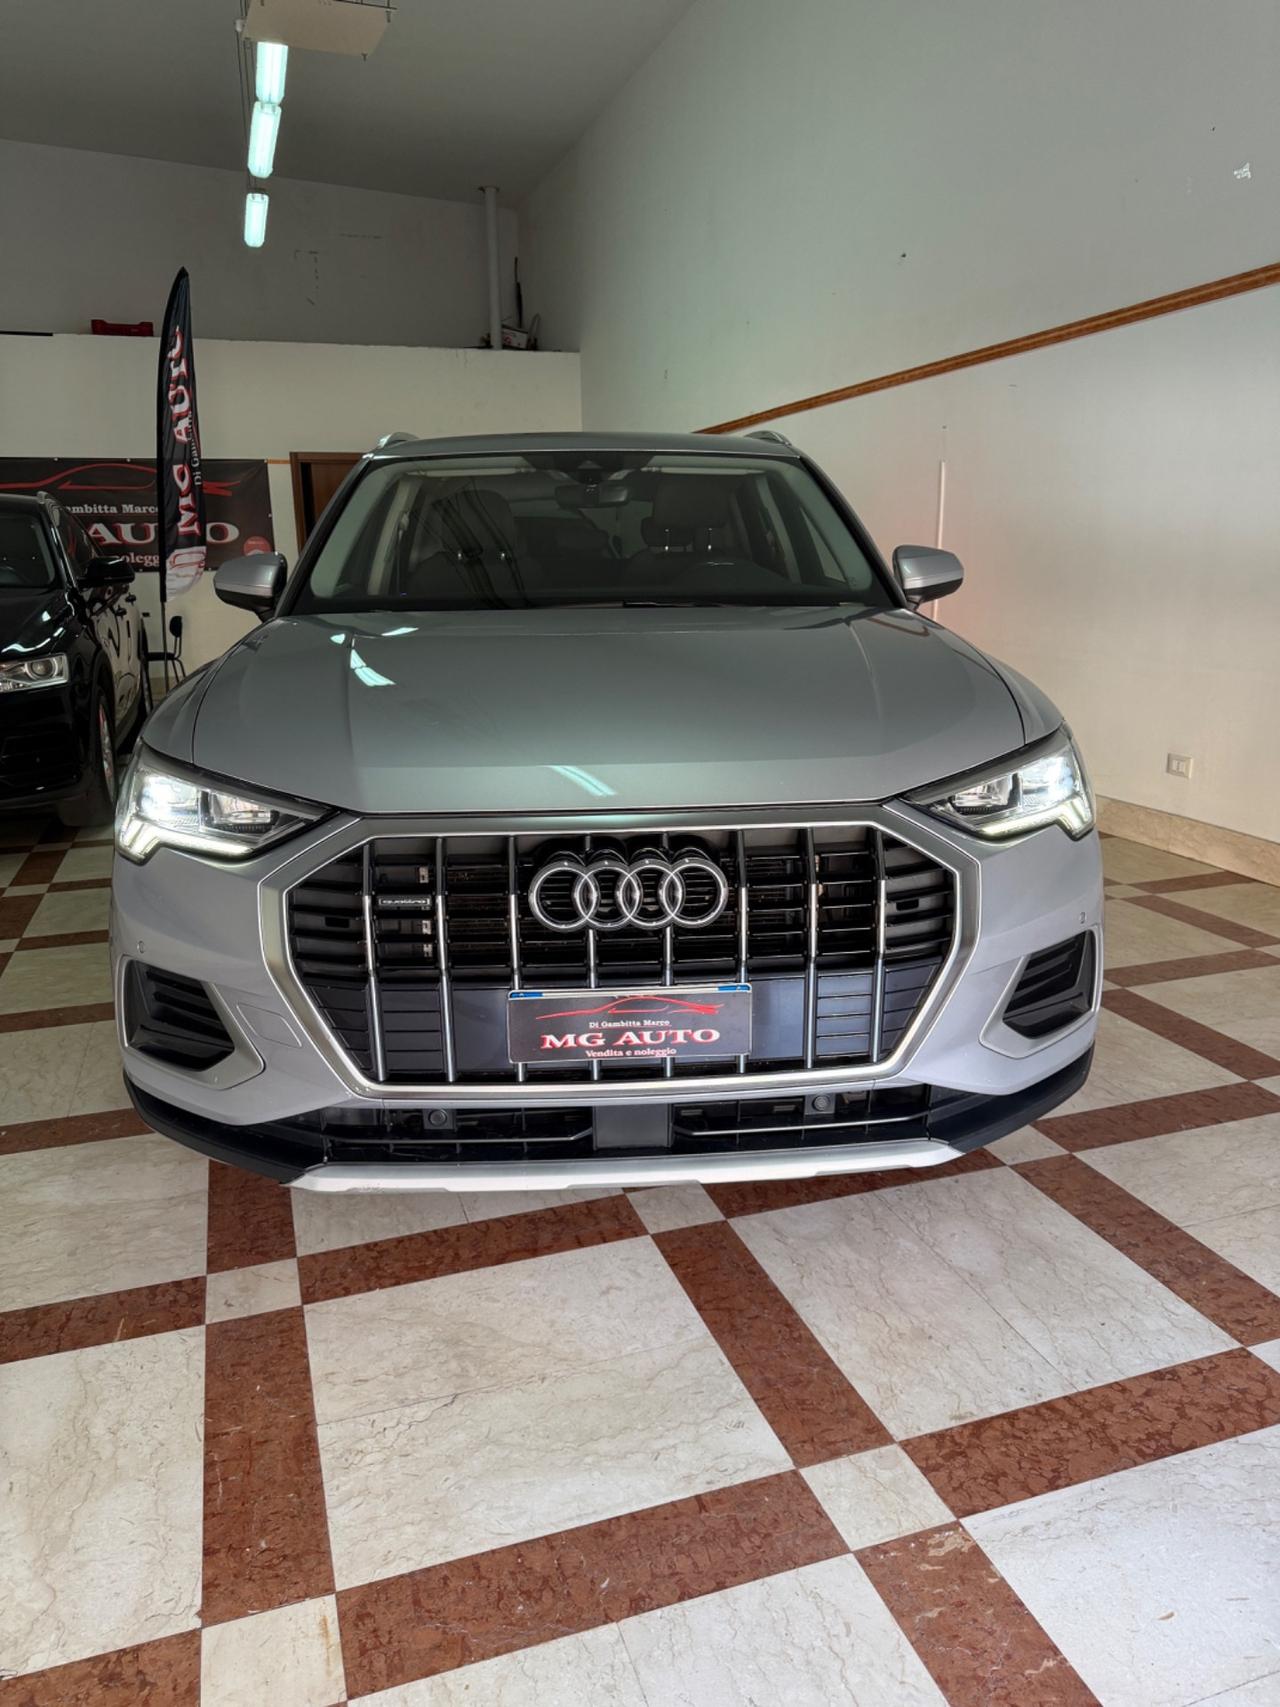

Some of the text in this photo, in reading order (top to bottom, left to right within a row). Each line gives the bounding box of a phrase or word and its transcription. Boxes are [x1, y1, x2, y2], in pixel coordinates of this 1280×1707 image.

[121, 504, 159, 514] Marc
[589, 1019, 670, 1029] Di Gambitta Marco
[540, 1029, 721, 1049] MG AUTO
[585, 1050, 624, 1058] Vendita
[634, 1047, 677, 1058] noleggio
